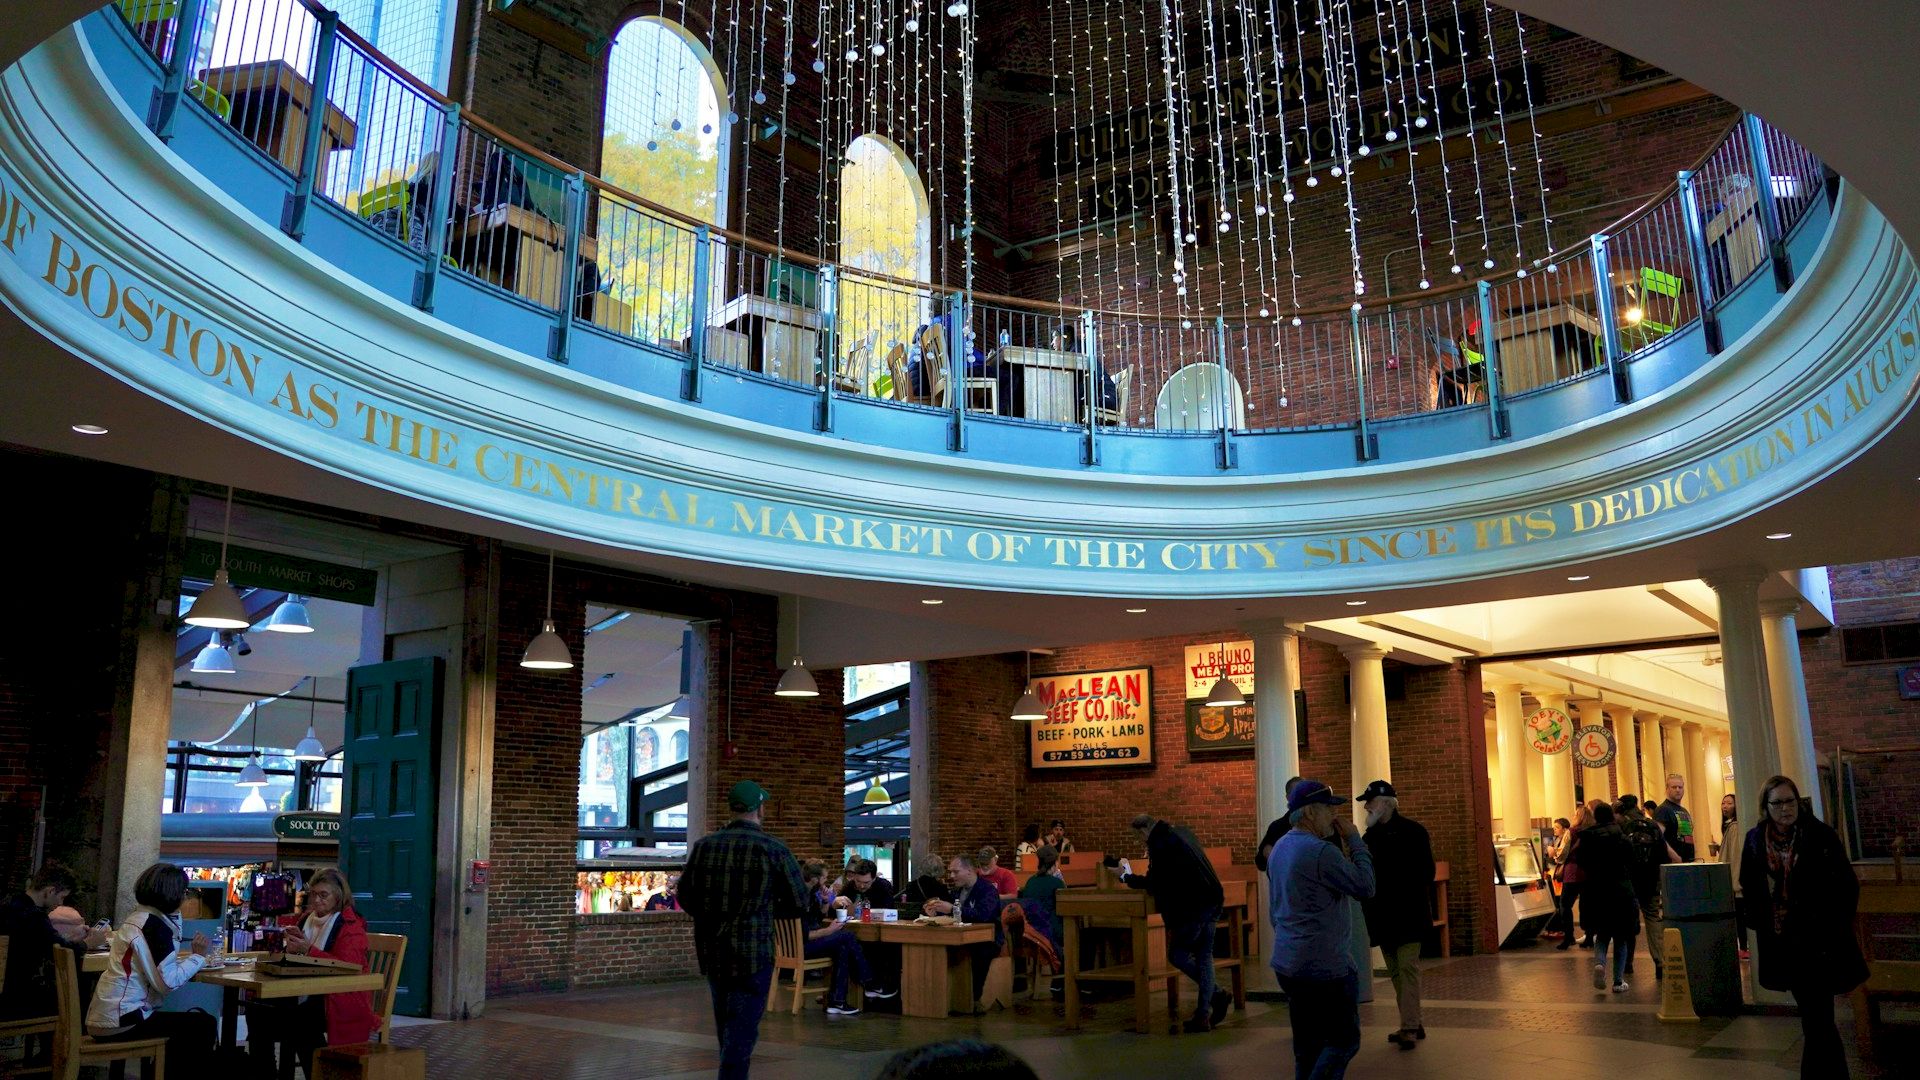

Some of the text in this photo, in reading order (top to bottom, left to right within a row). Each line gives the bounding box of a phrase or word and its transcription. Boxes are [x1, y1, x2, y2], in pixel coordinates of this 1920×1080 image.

[1060, 109, 1168, 164] JULIUS
[1369, 27, 1450, 75] SON
[0, 176, 36, 256] F
[41, 229, 263, 397] BOSTON
[269, 371, 339, 429] AS
[354, 400, 459, 470] THE
[475, 444, 715, 529] CENTRAL
[731, 501, 953, 558] MARKET
[967, 531, 1032, 563] OF
[1044, 537, 1145, 569] THE
[1161, 541, 1288, 571] CITY
[1304, 526, 1456, 568] SINCE
[1473, 509, 1556, 551] ITS
[1569, 420, 1795, 533] DEDICATION
[1800, 393, 1834, 449] IN
[201, 553, 356, 592] TO SOUTH MARKET SHOPS
[1209, 648, 1251, 667] BRUNO
[1231, 662, 1254, 674] PRO
[1045, 701, 1078, 723] BEEF
[1233, 706, 1255, 716] EMPIR
[1528, 710, 1564, 729] JOEY'S
[1038, 724, 1144, 741] BEEF PORK LAMB
[1575, 725, 1612, 740] ELEVATOR
[1073, 742, 1107, 750] STALLS
[1574, 750, 1614, 768] RESTROOMS
[290, 820, 340, 831] SOCK IT TO
